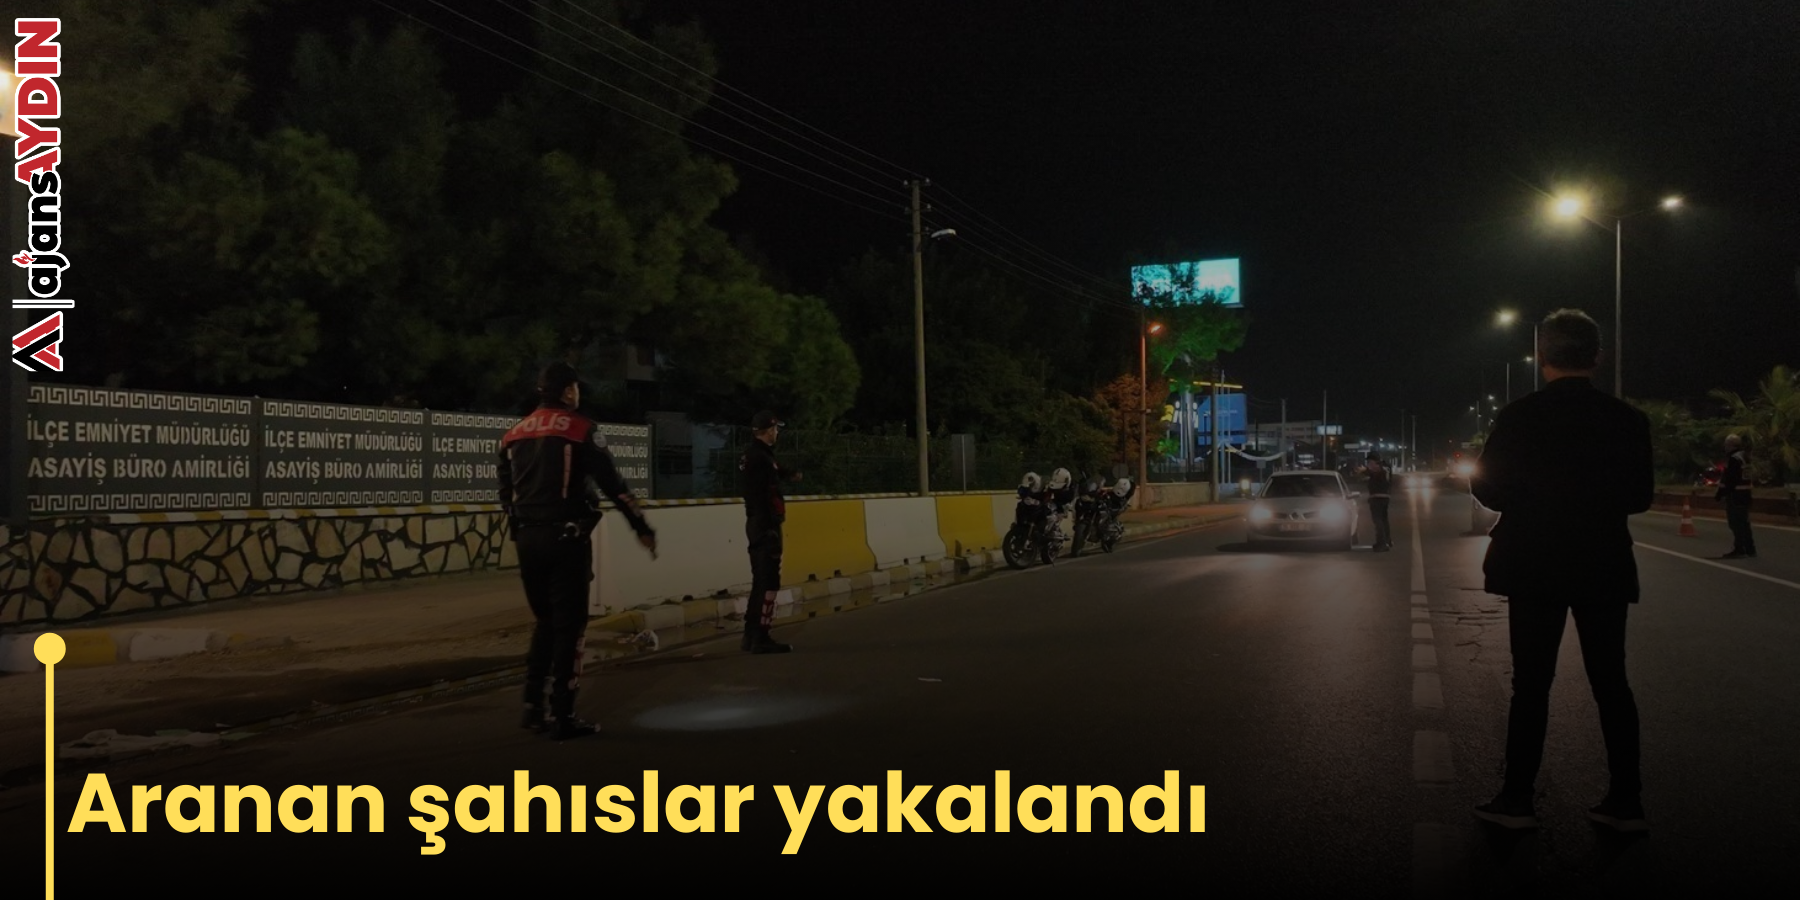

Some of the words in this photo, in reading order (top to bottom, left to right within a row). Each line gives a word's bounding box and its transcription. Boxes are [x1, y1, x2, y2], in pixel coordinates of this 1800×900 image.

[27, 413, 69, 448] İLÇE
[75, 417, 152, 444] EMNİYET
[156, 420, 250, 447] MÜDÜRLÜĞÜ
[265, 424, 295, 454] İLÇE
[298, 427, 352, 450] EMNİYET
[355, 430, 423, 452] MÜDÜRLÜĞÜ
[432, 432, 454, 458] İLÇE
[456, 435, 497, 454] EMNİYET
[27, 451, 107, 485] ASAYİŞ
[113, 453, 167, 478] BÜRO
[171, 453, 250, 478] AMİRLİĞİ
[265, 456, 320, 485] ASAYİŞ
[324, 457, 362, 479] BÜRO
[365, 457, 423, 479] AMİRLİĞİ
[432, 459, 473, 484] ASAYİŞ
[475, 460, 498, 479] BÜR
